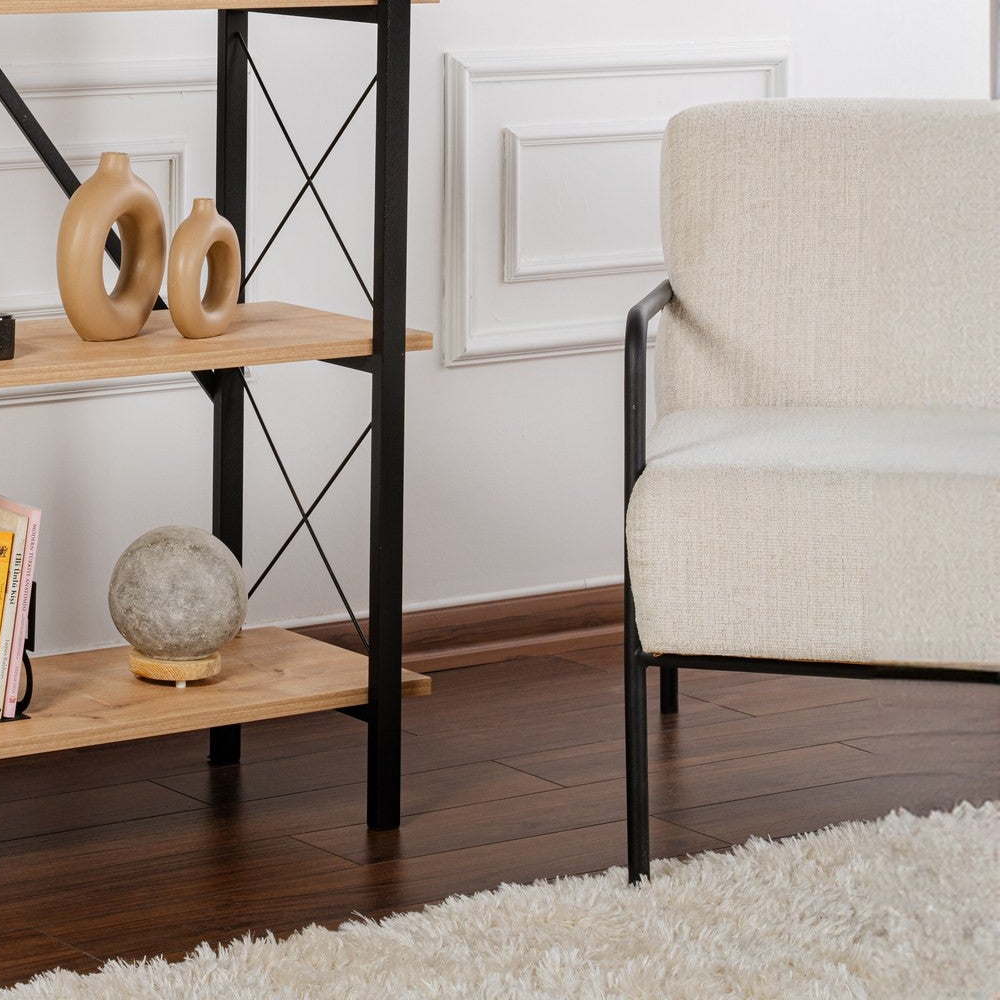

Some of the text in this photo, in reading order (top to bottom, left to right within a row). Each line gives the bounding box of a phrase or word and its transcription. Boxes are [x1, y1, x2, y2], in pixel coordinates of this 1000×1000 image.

[29, 523, 37, 551] MODERN
[12, 568, 21, 588] Ünlü
[9, 590, 17, 605] Kişi
